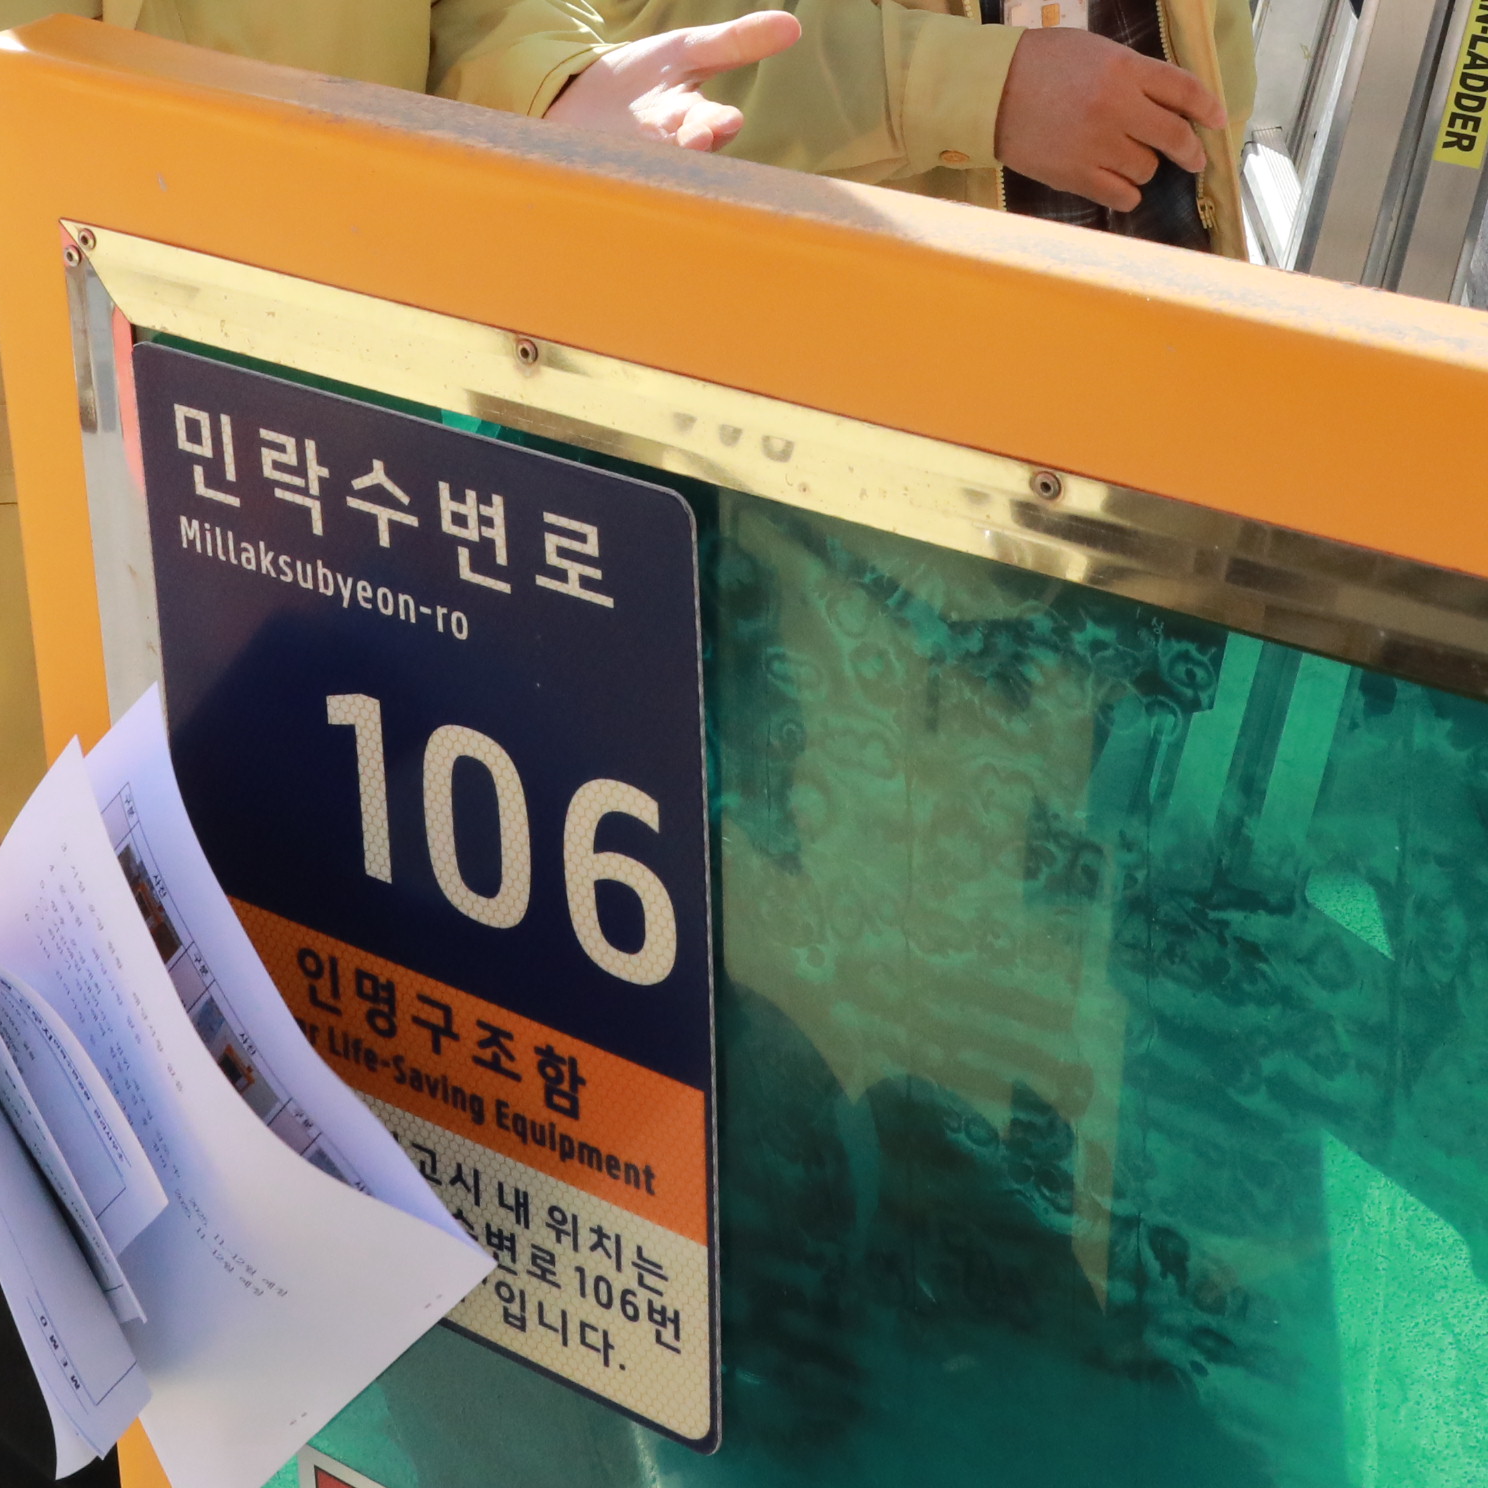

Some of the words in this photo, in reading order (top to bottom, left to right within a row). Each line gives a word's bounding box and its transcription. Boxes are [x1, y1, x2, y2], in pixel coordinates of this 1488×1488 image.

[174, 403, 614, 610] 민락수변로
[179, 514, 470, 641] Millaksubyeon-ro
[326, 693, 678, 987] 106
[296, 946, 587, 1121] 인명구조함
[329, 1032, 486, 1127] Life-Saving
[495, 1098, 656, 1197] Equipment
[498, 1181, 531, 1230] 내
[545, 1203, 670, 1297] 위치는
[575, 1264, 683, 1355] 106번
